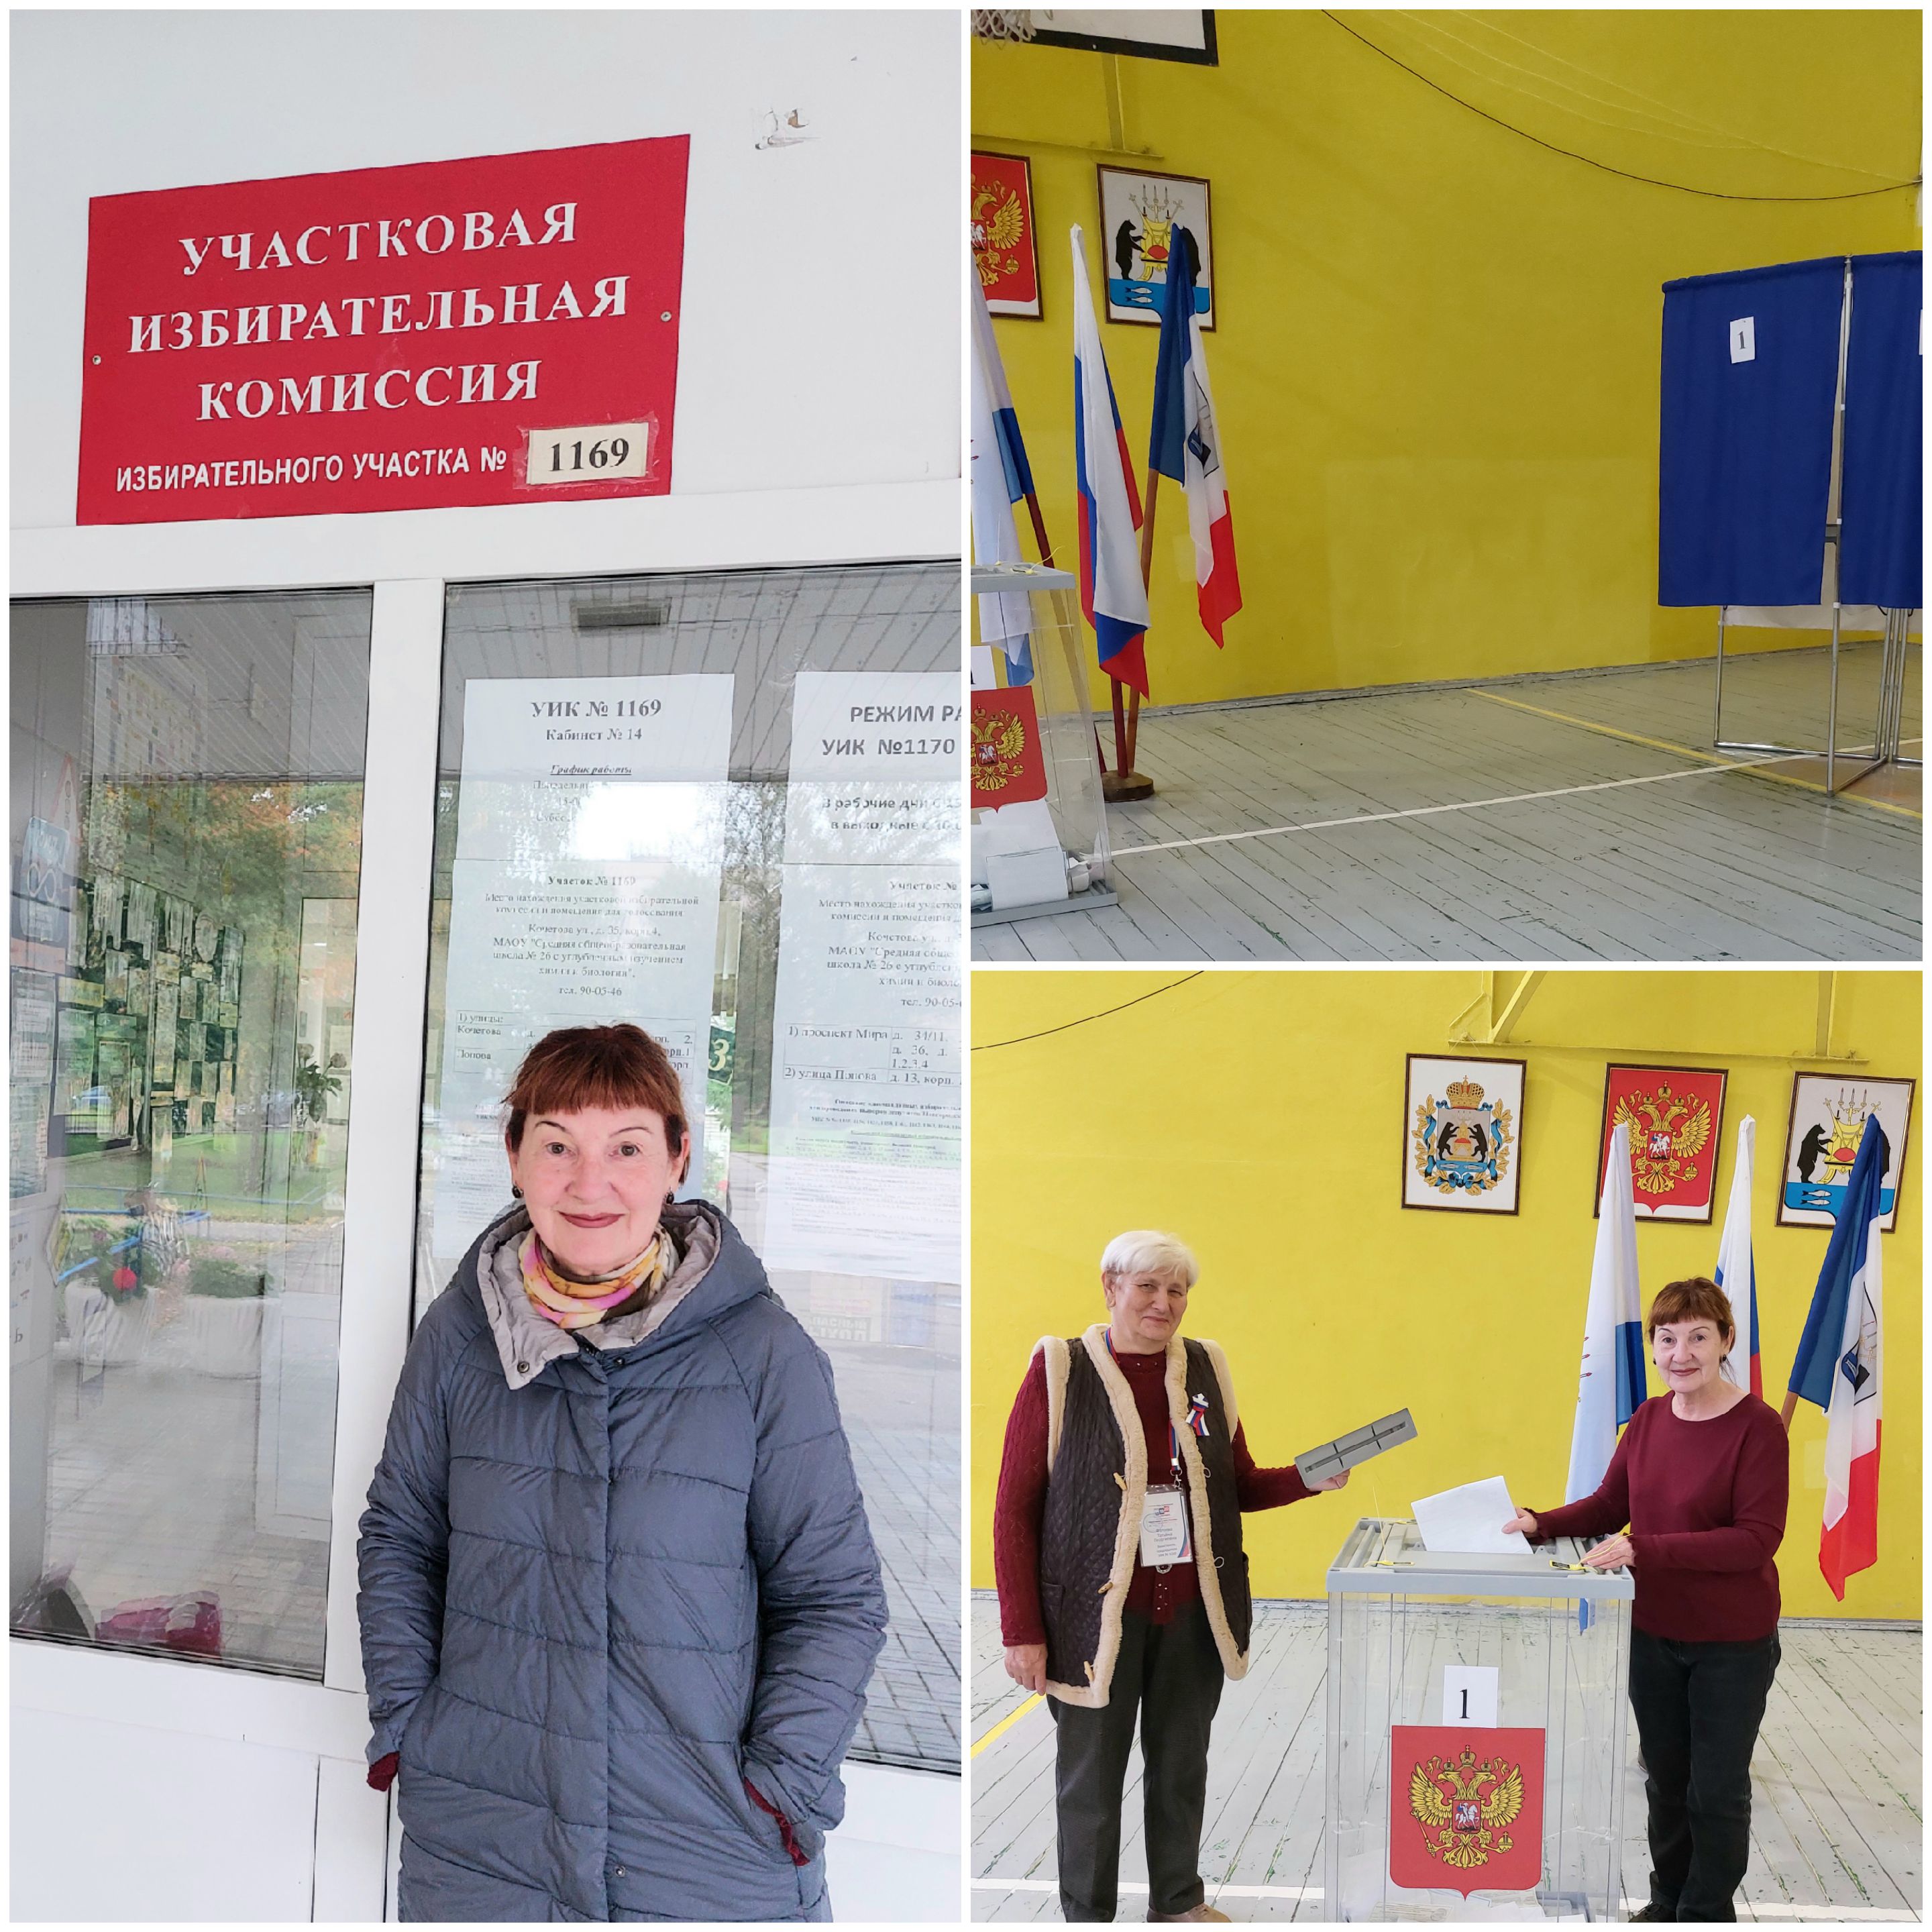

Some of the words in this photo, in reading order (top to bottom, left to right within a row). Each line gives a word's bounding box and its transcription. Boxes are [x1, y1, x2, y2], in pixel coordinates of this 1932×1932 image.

[178, 203, 579, 276] УЧАСТКОВАЯ
[127, 276, 631, 354] ИЗБИРАТЕЛЬНАЯ
[1738, 331, 1746, 350] 1
[196, 360, 543, 421] КОМИССИЯ
[115, 453, 343, 493] ИЗБИРАТЕЛЬНОГО
[352, 445, 470, 481] УЧАСТКА
[481, 445, 508, 471] №
[547, 437, 630, 474] 1169
[531, 701, 580, 718] УИК
[586, 701, 608, 717] №
[616, 699, 661, 717] 1169
[851, 706, 934, 722] РЕЖИМ
[547, 729, 603, 740] Кабинет
[606, 728, 623, 740] №
[628, 728, 642, 740] 14
[822, 739, 865, 755] УИК
[877, 739, 955, 755] №1170
[551, 765, 589, 775] График
[835, 797, 895, 811] рабочие
[548, 876, 592, 885] Участок
[612, 876, 636, 886] 1169
[890, 881, 941, 890] Участок
[819, 899, 851, 908] Место
[493, 937, 528, 947] МАОУ
[540, 951, 551, 961] 26
[828, 946, 866, 955] МАОУ
[827, 961, 861, 969] школа
[863, 959, 877, 969] №
[880, 960, 893, 970] 26
[788, 1026, 798, 1037] 1)
[802, 1028, 853, 1038] проспект
[856, 1028, 888, 1041] Мира
[785, 1067, 796, 1078] 2)
[798, 1069, 832, 1079] улица
[1458, 1688, 1470, 1719] 1
